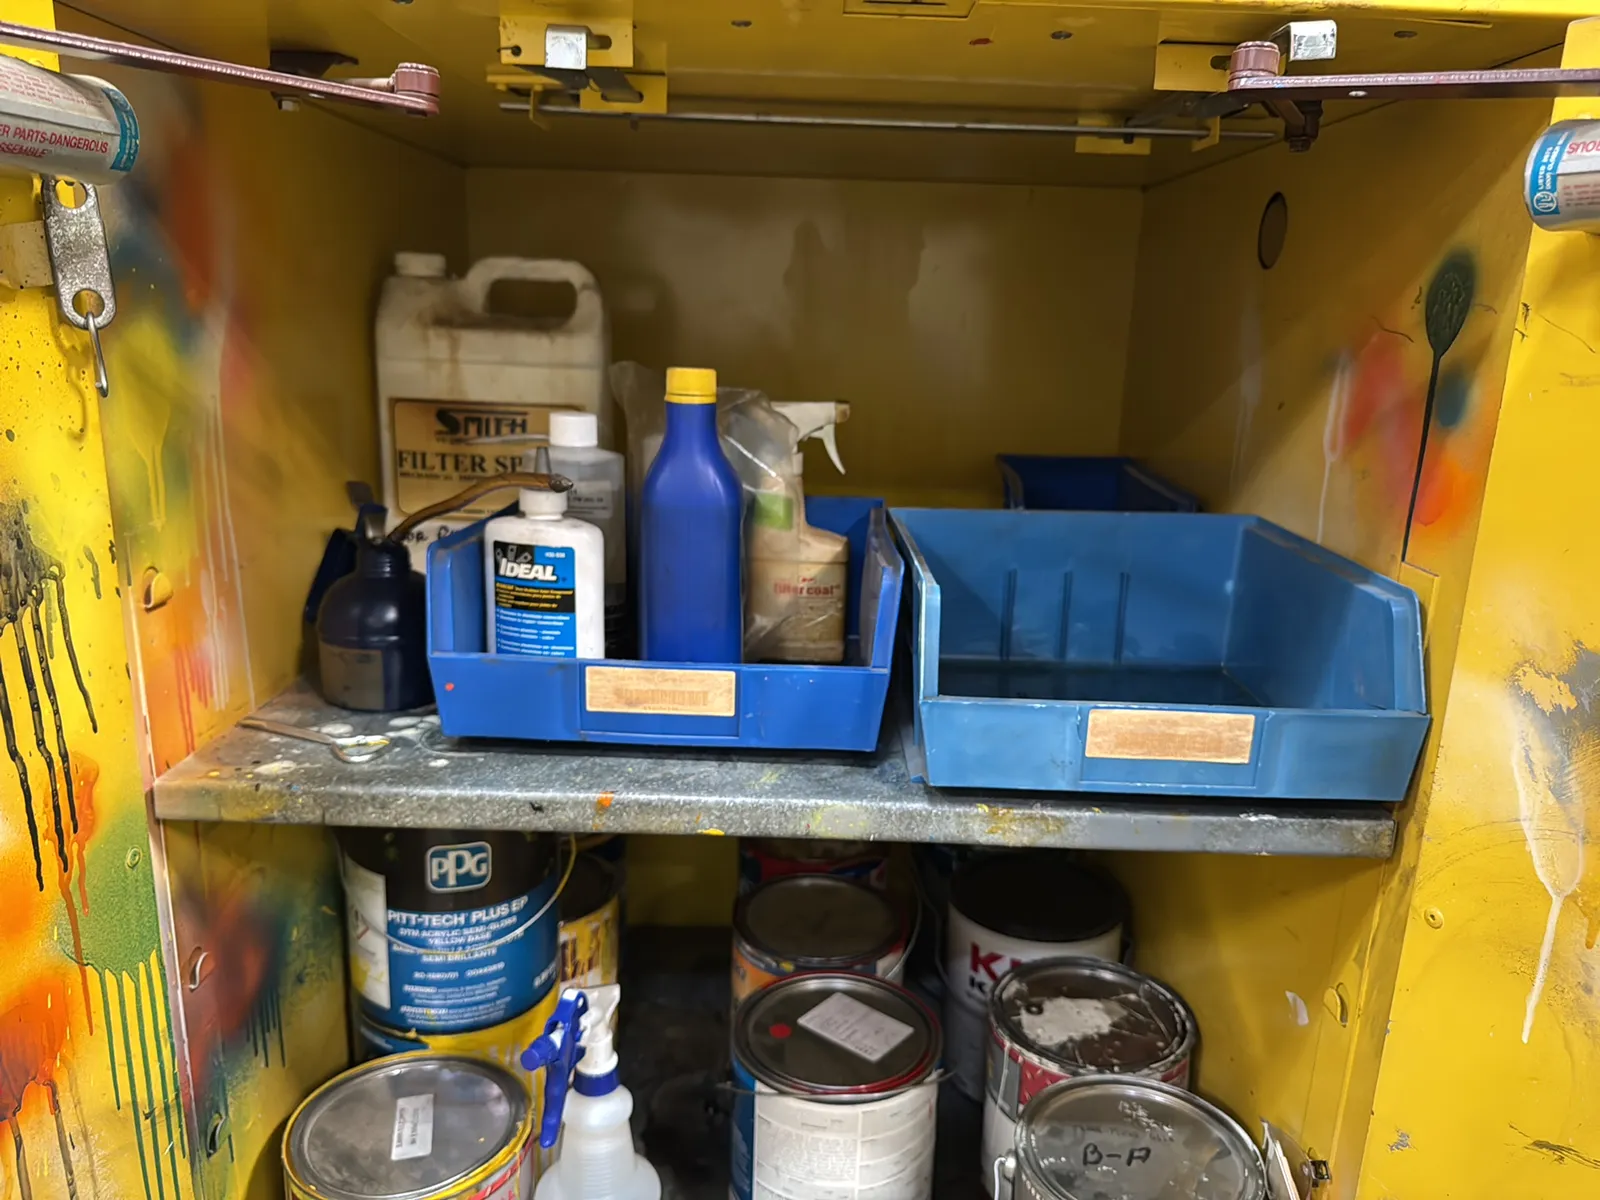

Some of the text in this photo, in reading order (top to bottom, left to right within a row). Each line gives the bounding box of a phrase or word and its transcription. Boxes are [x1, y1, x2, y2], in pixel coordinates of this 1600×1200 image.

[435, 408, 528, 437] SMITH
[398, 451, 487, 474] FILTER
[500, 557, 558, 581] IDEAL
[431, 849, 487, 886] PPG
[471, 903, 509, 924] PLUS
[511, 895, 528, 913] EP
